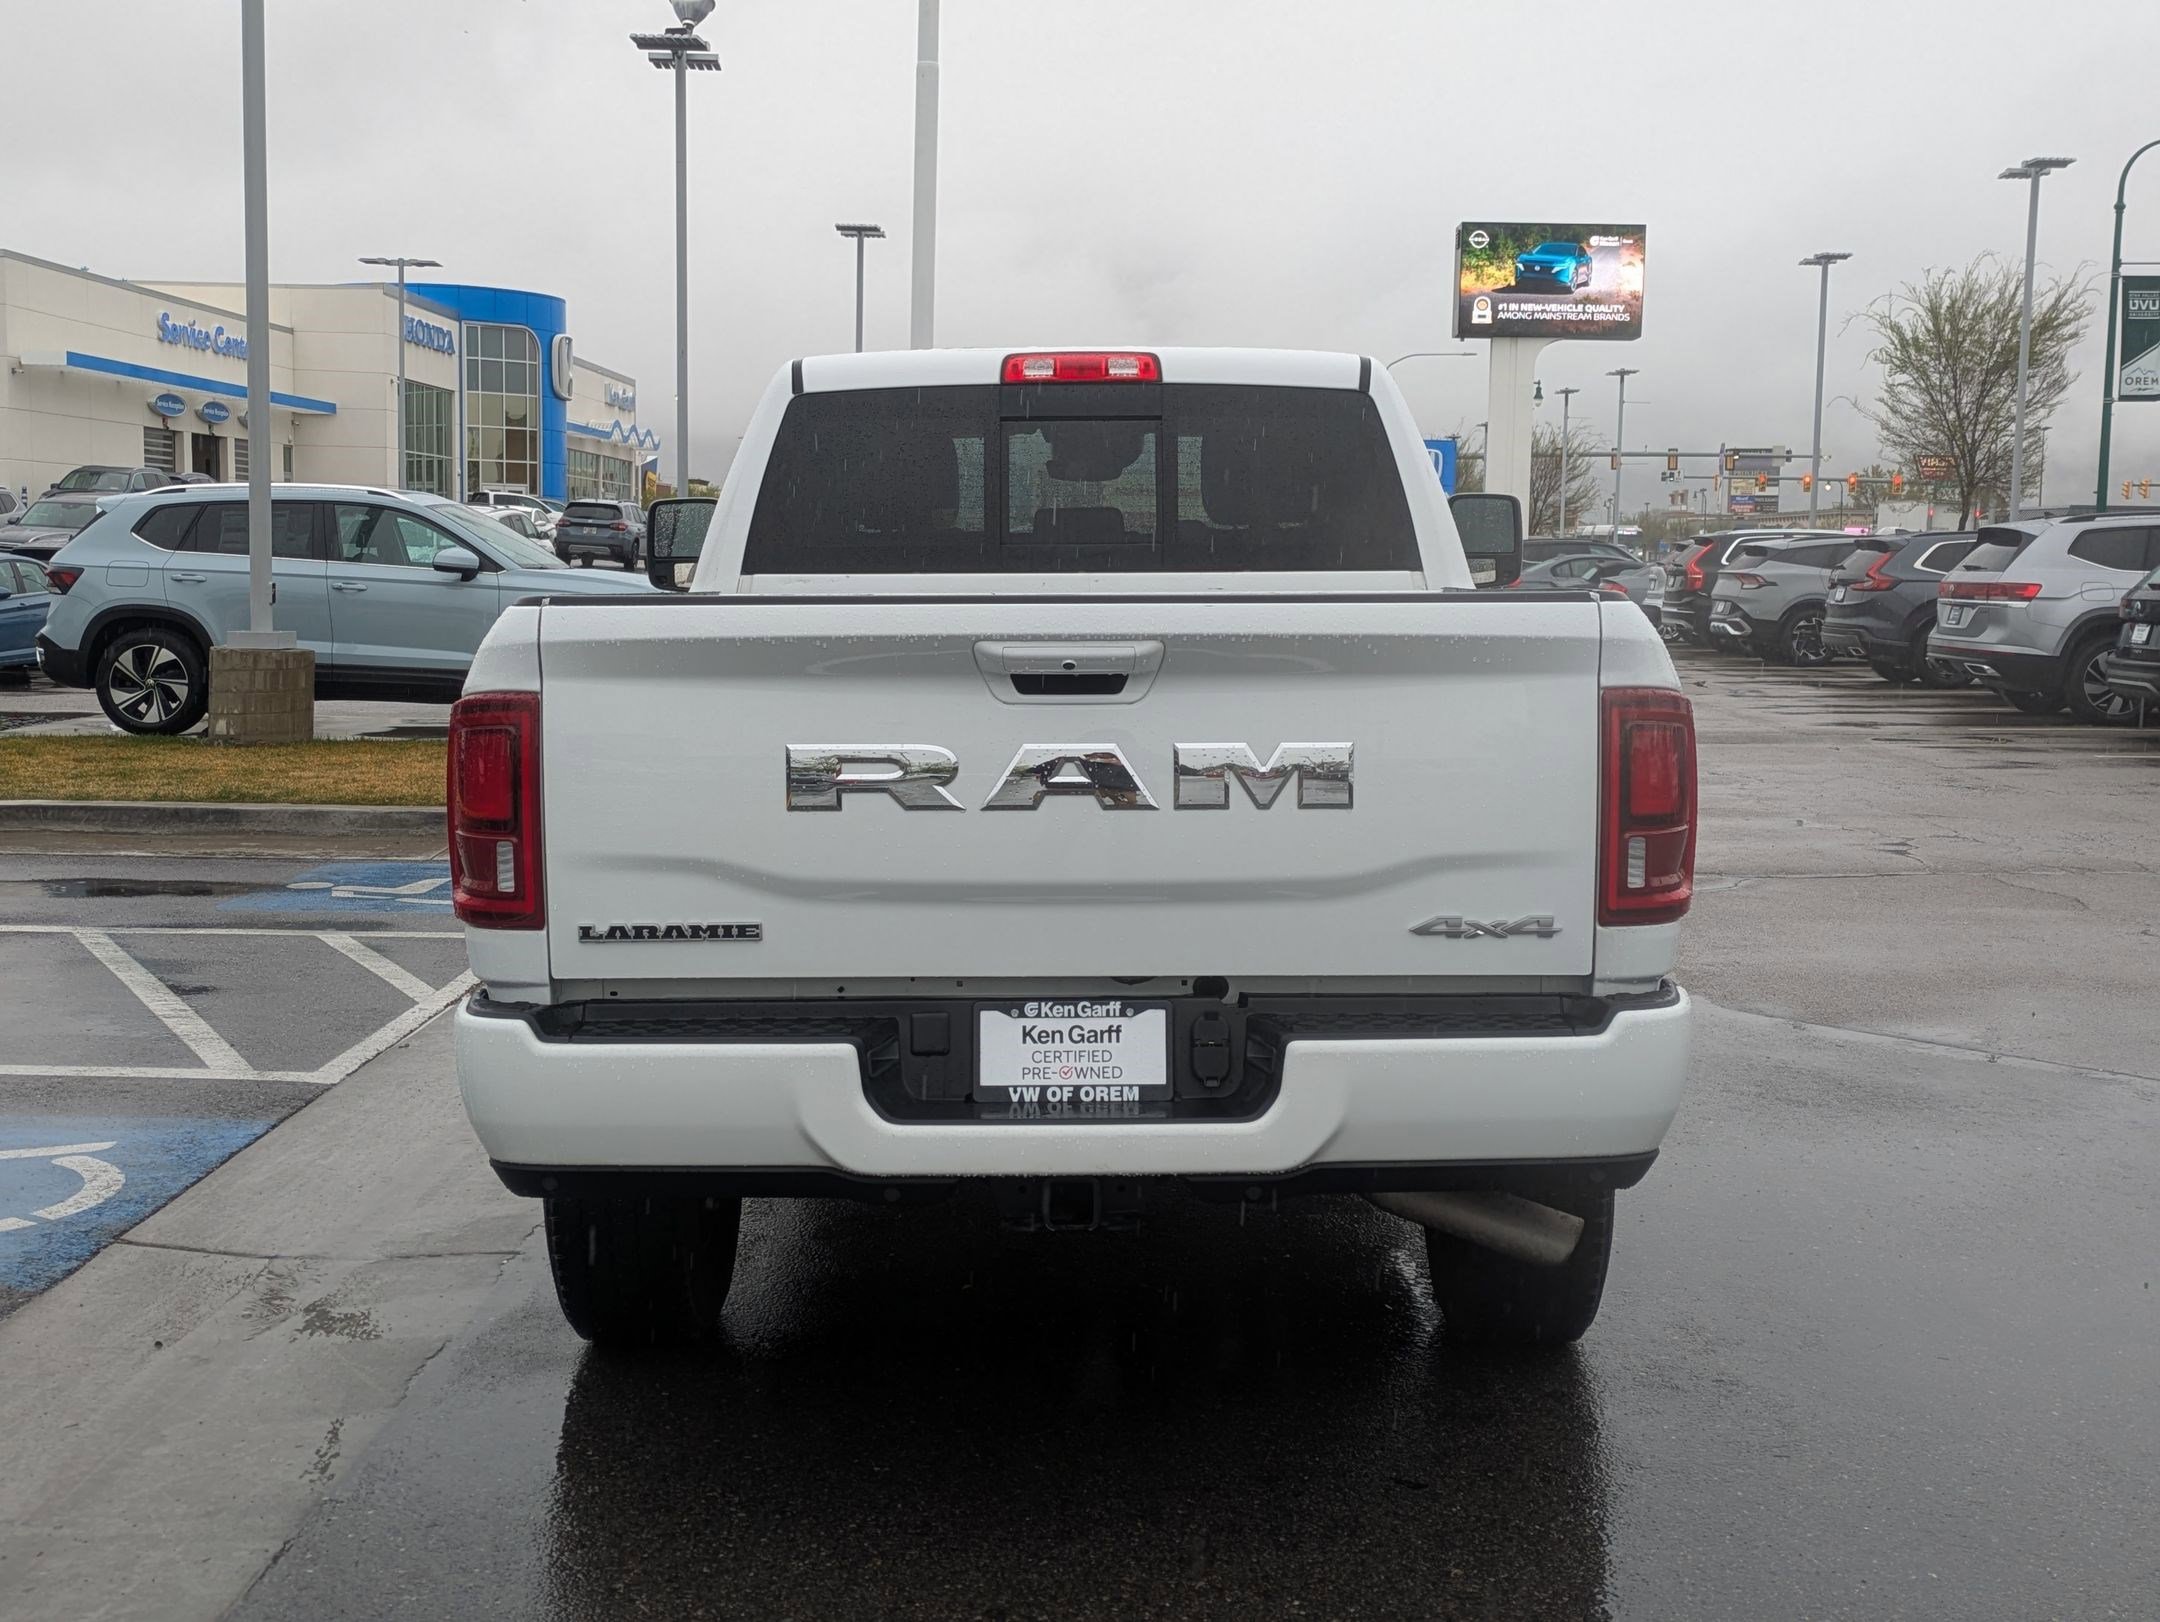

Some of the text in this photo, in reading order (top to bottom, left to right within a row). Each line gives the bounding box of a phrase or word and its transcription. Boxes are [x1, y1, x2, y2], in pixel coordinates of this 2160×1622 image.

[1509, 303, 1519, 311] IN
[1520, 304, 1584, 312] NEW-VEHICLE
[1585, 304, 1625, 312] QUALITY
[2129, 299, 2159, 310] UVU
[1497, 312, 1630, 321] AMONG MAINSTREAM BRANDS
[157, 312, 248, 361] Service Cent
[404, 316, 456, 355] HONDA
[2124, 376, 2159, 386] OREM
[785, 742, 1355, 811] RAM
[578, 922, 763, 943] LARAMIE
[1408, 914, 1564, 939] 4x4
[1040, 1001, 1121, 1018] Ken Garff
[1022, 1024, 1122, 1044] Ken Garff
[1031, 1050, 1113, 1063] CERTIFIED
[1008, 1086, 1140, 1102] VW OF OREM
